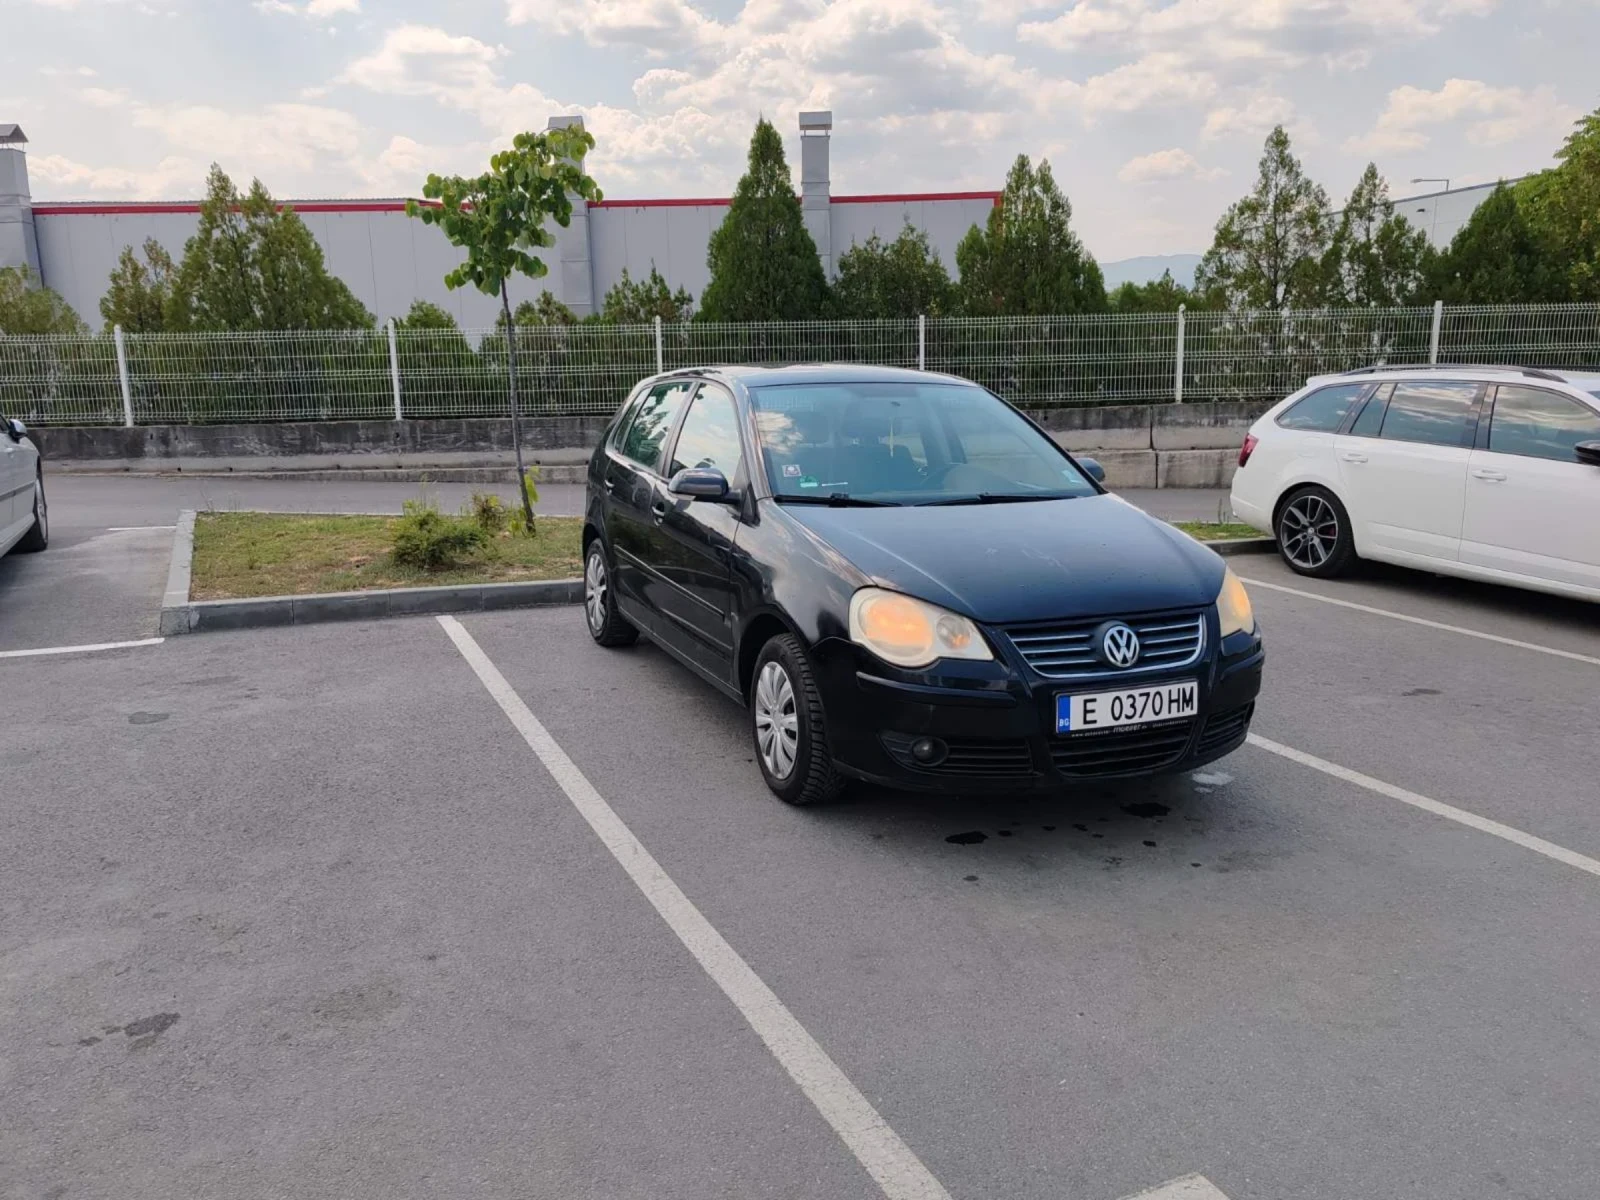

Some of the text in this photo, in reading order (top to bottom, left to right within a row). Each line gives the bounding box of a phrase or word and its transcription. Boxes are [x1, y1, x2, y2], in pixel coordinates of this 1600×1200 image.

[1104, 625, 1140, 668] VW
[1059, 718, 1070, 727] BG
[1082, 698, 1097, 725] E
